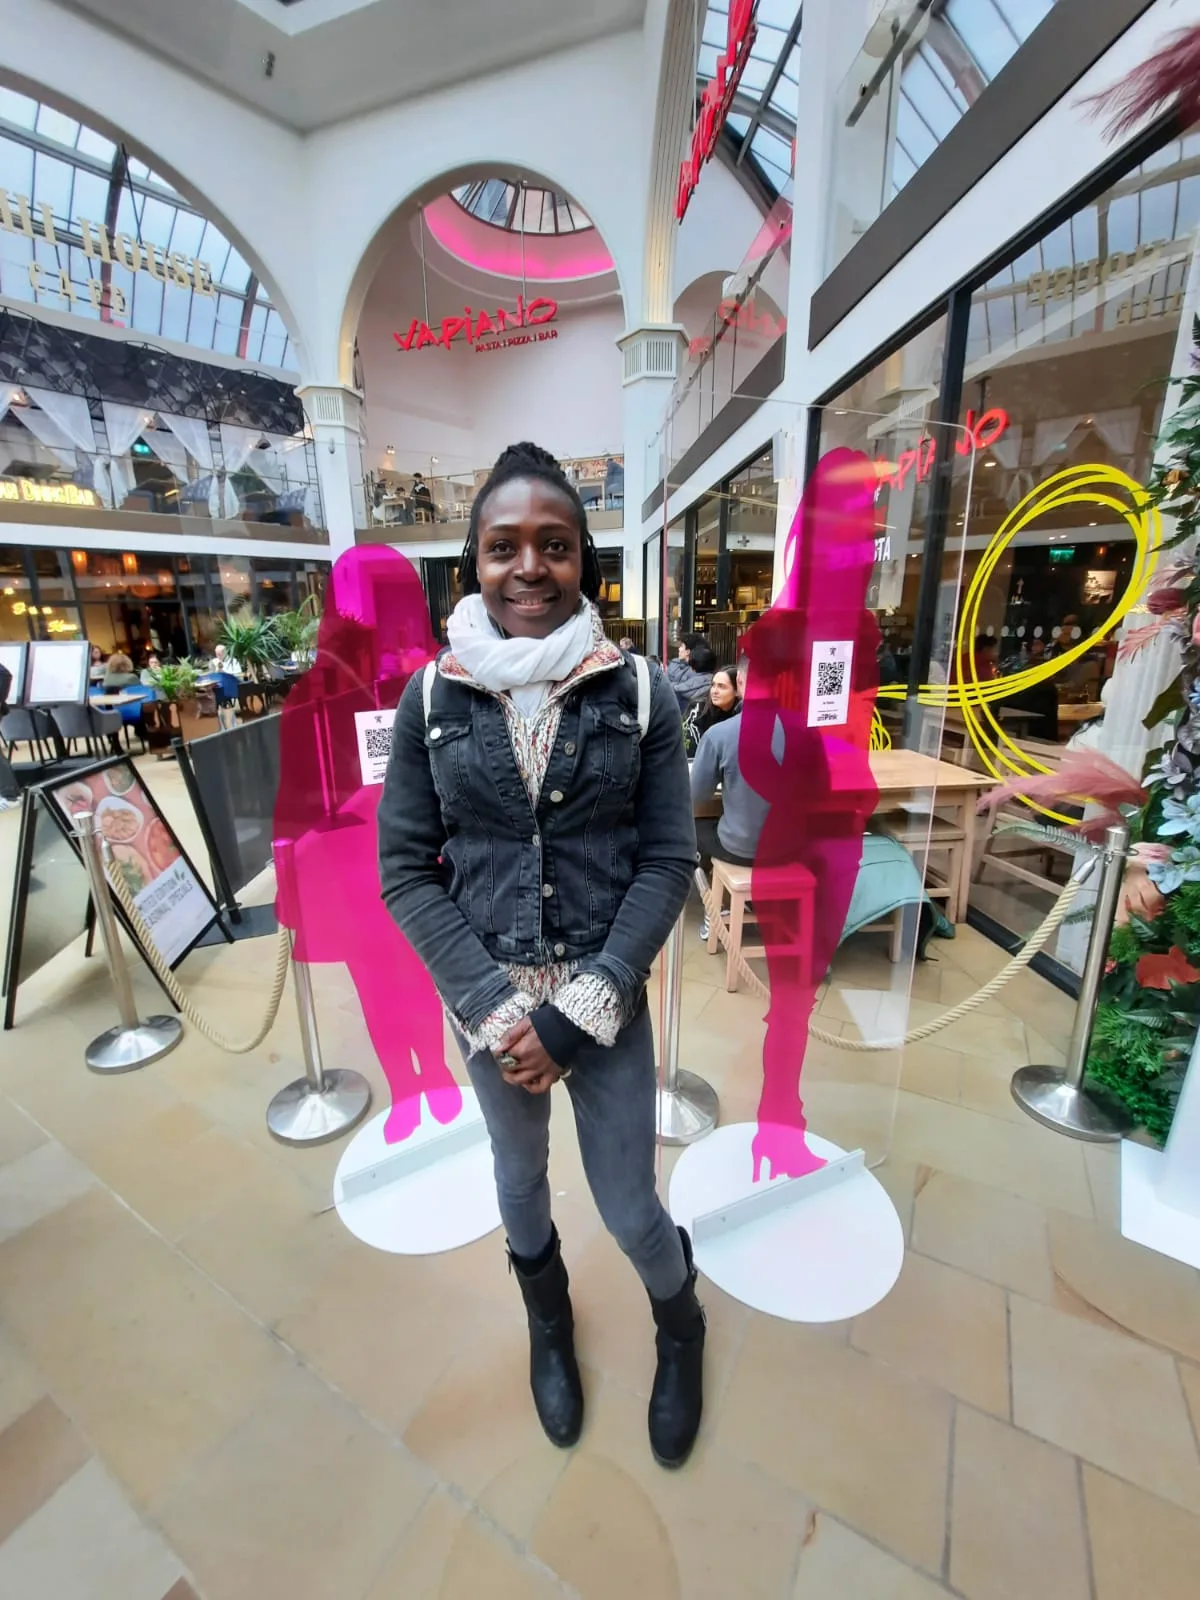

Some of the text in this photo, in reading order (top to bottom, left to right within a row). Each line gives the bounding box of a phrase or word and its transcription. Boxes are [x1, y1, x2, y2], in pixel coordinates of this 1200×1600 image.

[77, 216, 216, 297] HOUSE
[28, 260, 129, 317] CAFE
[475, 329, 558, 352] PASTA PIZZA BAR
